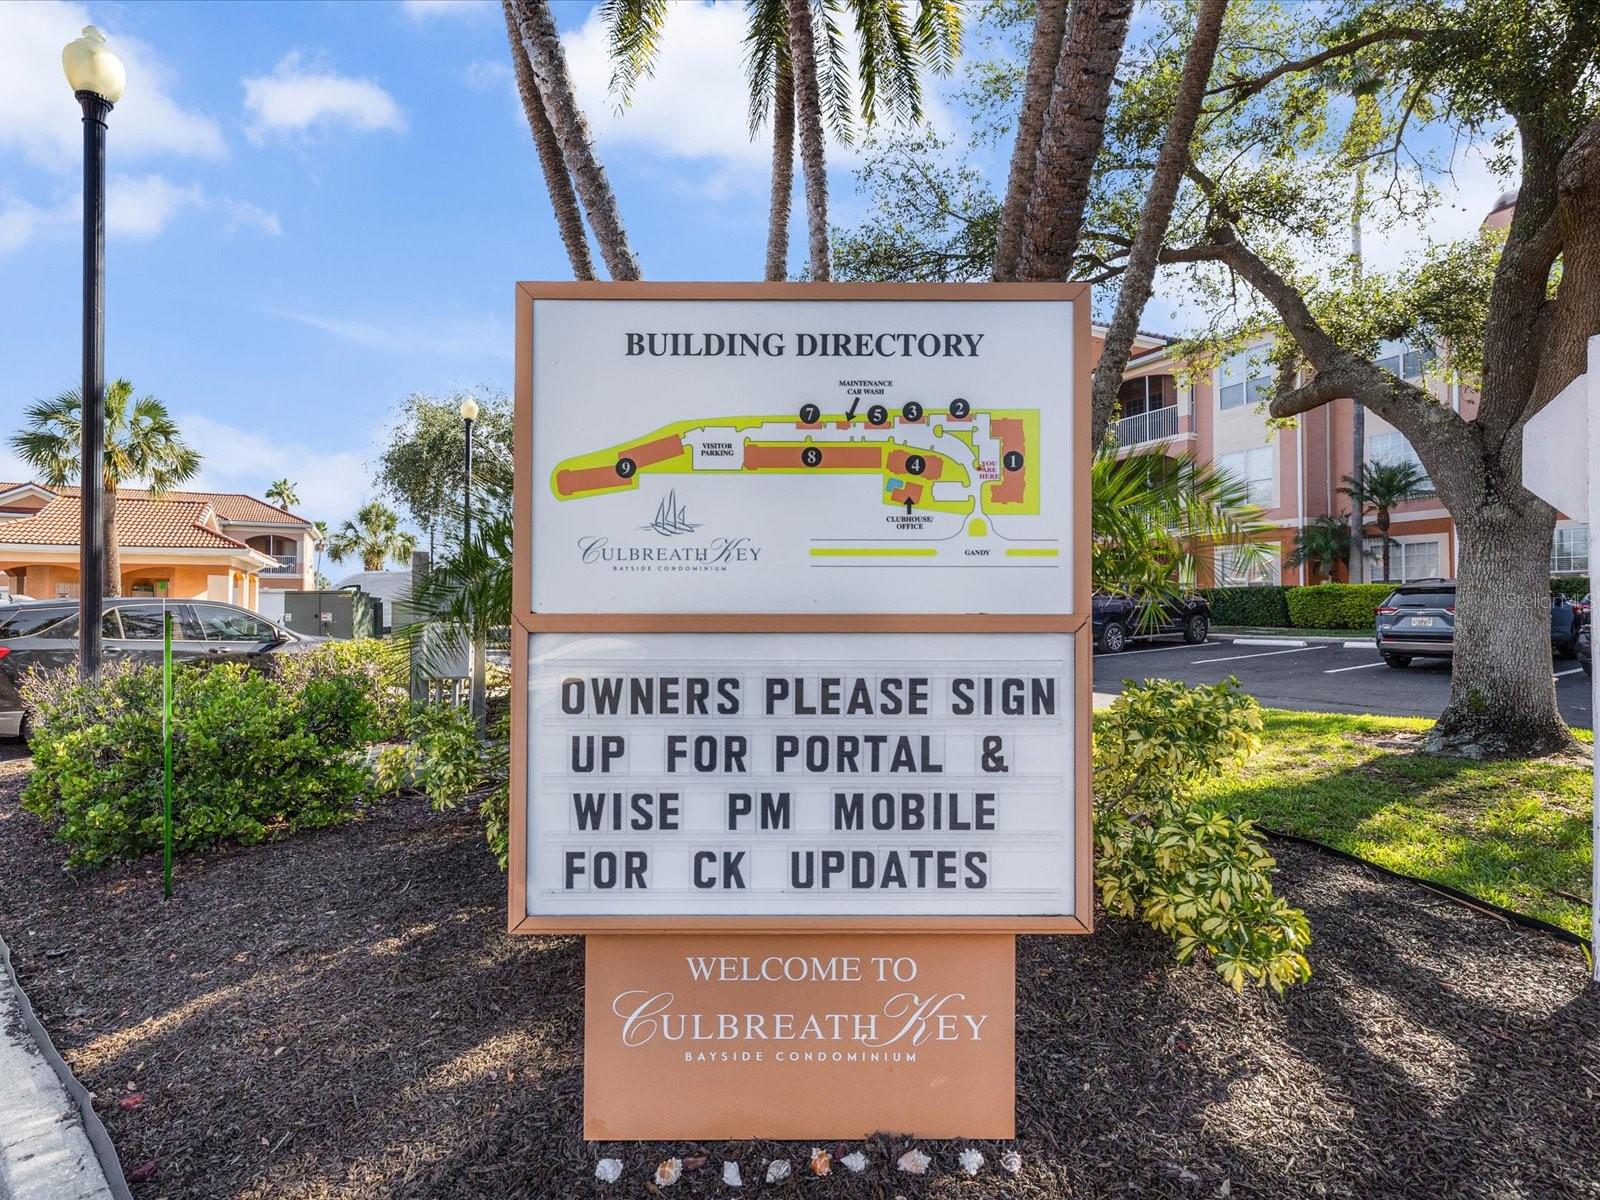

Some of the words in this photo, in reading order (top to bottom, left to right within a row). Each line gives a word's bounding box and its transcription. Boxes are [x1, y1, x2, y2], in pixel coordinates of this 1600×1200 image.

[625, 332, 786, 357] BUILDING
[796, 332, 985, 357] DIRECTORY
[839, 380, 893, 388] MAINTENANCE
[847, 388, 862, 396] CAR
[863, 388, 885, 396] WASH
[806, 407, 814, 420] 7
[908, 403, 917, 417] 3
[955, 400, 964, 414] 2
[873, 408, 882, 422] 5
[702, 442, 733, 450] VISITOR
[807, 450, 816, 464] 8
[621, 462, 630, 475] 9
[911, 459, 920, 473] 4
[577, 536, 708, 564] CULBREATH
[700, 536, 762, 564] KEY
[965, 549, 990, 557] GANDY
[561, 677, 740, 715] OWNERS
[765, 677, 929, 715] PLEASE
[951, 677, 1056, 716] SIGN
[571, 735, 626, 773] UP
[667, 735, 748, 773] FOR
[775, 735, 943, 773] PORTAL
[981, 735, 1009, 773] &
[573, 792, 680, 831] WISE
[728, 792, 791, 831] PM
[834, 792, 996, 831] MOBILE
[565, 851, 648, 890] FOR
[693, 851, 747, 890] CK
[791, 850, 988, 889] UPDATES
[687, 957, 861, 983] WELCOME
[871, 957, 918, 983] TO
[612, 990, 879, 1047] CULBREATH
[861, 992, 989, 1048] KEY
[685, 1051, 765, 1062] BAYSIDE
[776, 1051, 918, 1062] CONDOMINIUM
